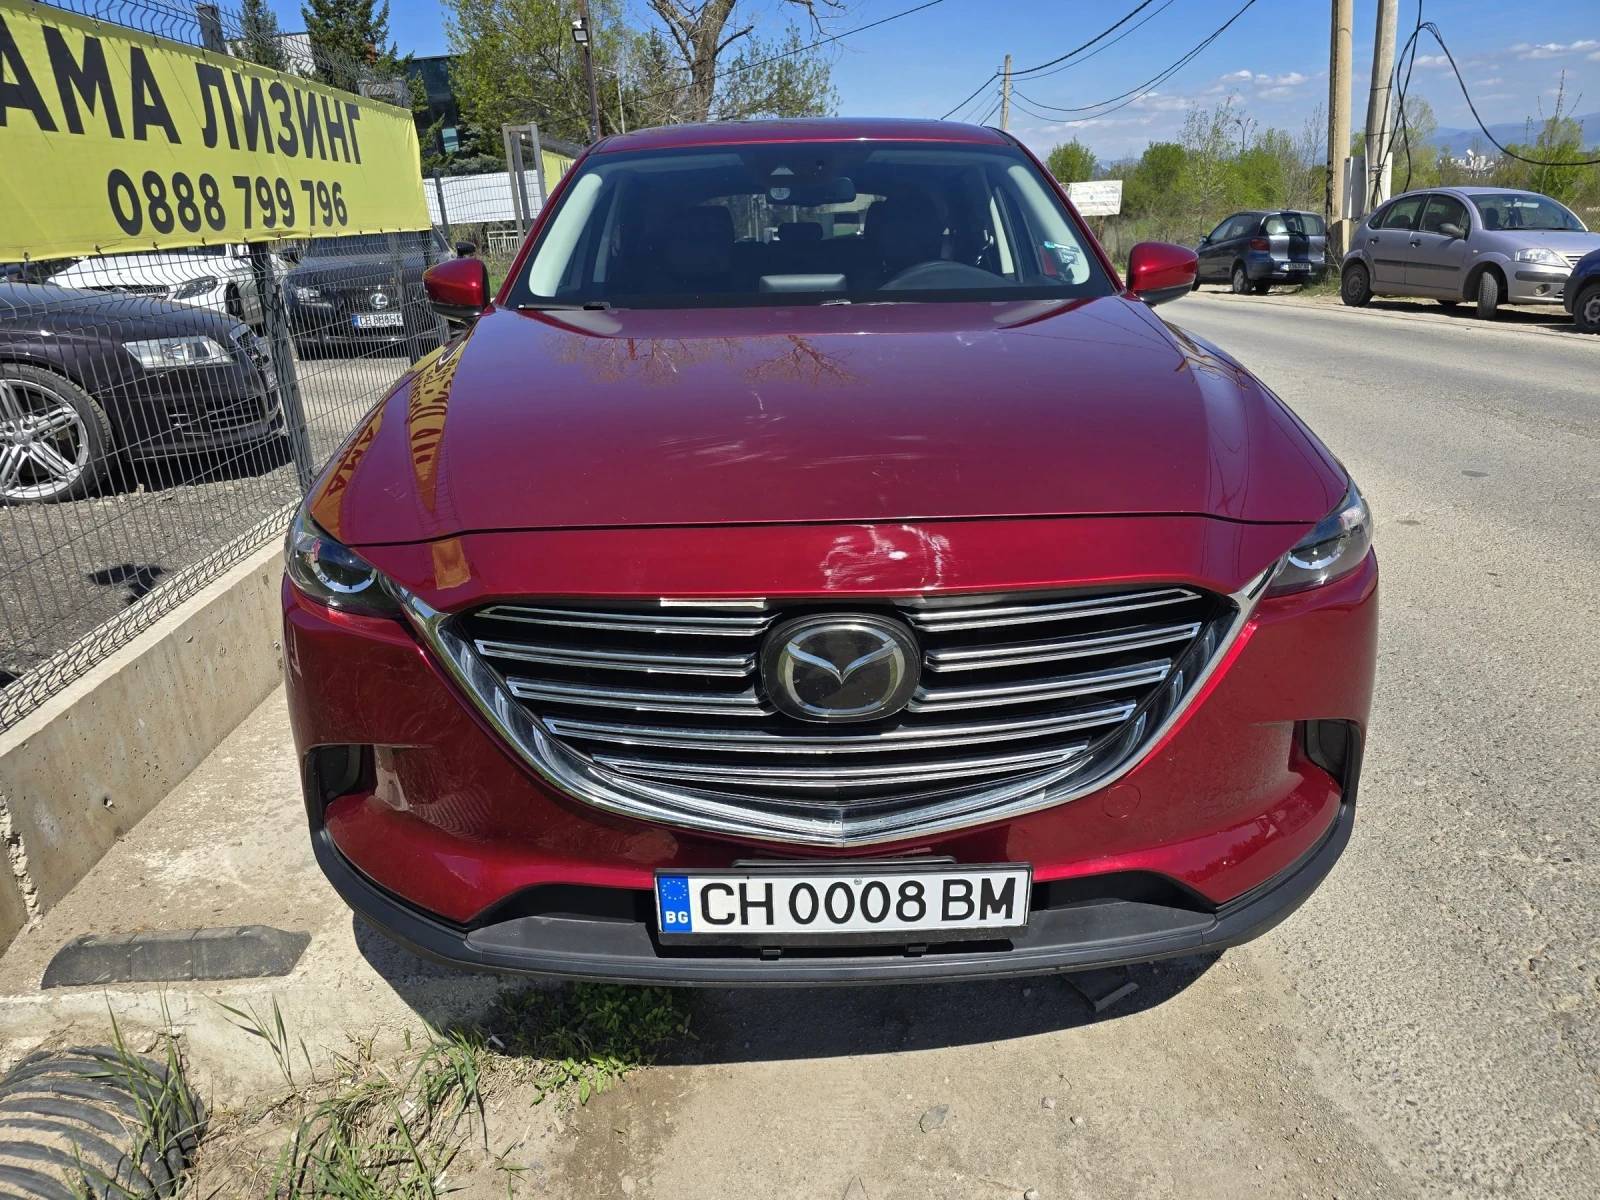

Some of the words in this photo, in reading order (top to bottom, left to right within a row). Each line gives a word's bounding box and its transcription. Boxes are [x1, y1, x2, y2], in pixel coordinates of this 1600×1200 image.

[195, 62, 362, 165] ЛИЗИНГ
[107, 168, 226, 237] 0888
[232, 175, 296, 230] 799
[300, 180, 348, 228] 796
[664, 910, 689, 925] BG
[699, 882, 774, 926] CH
[788, 880, 927, 925] 0008
[941, 877, 1016, 922] BM
